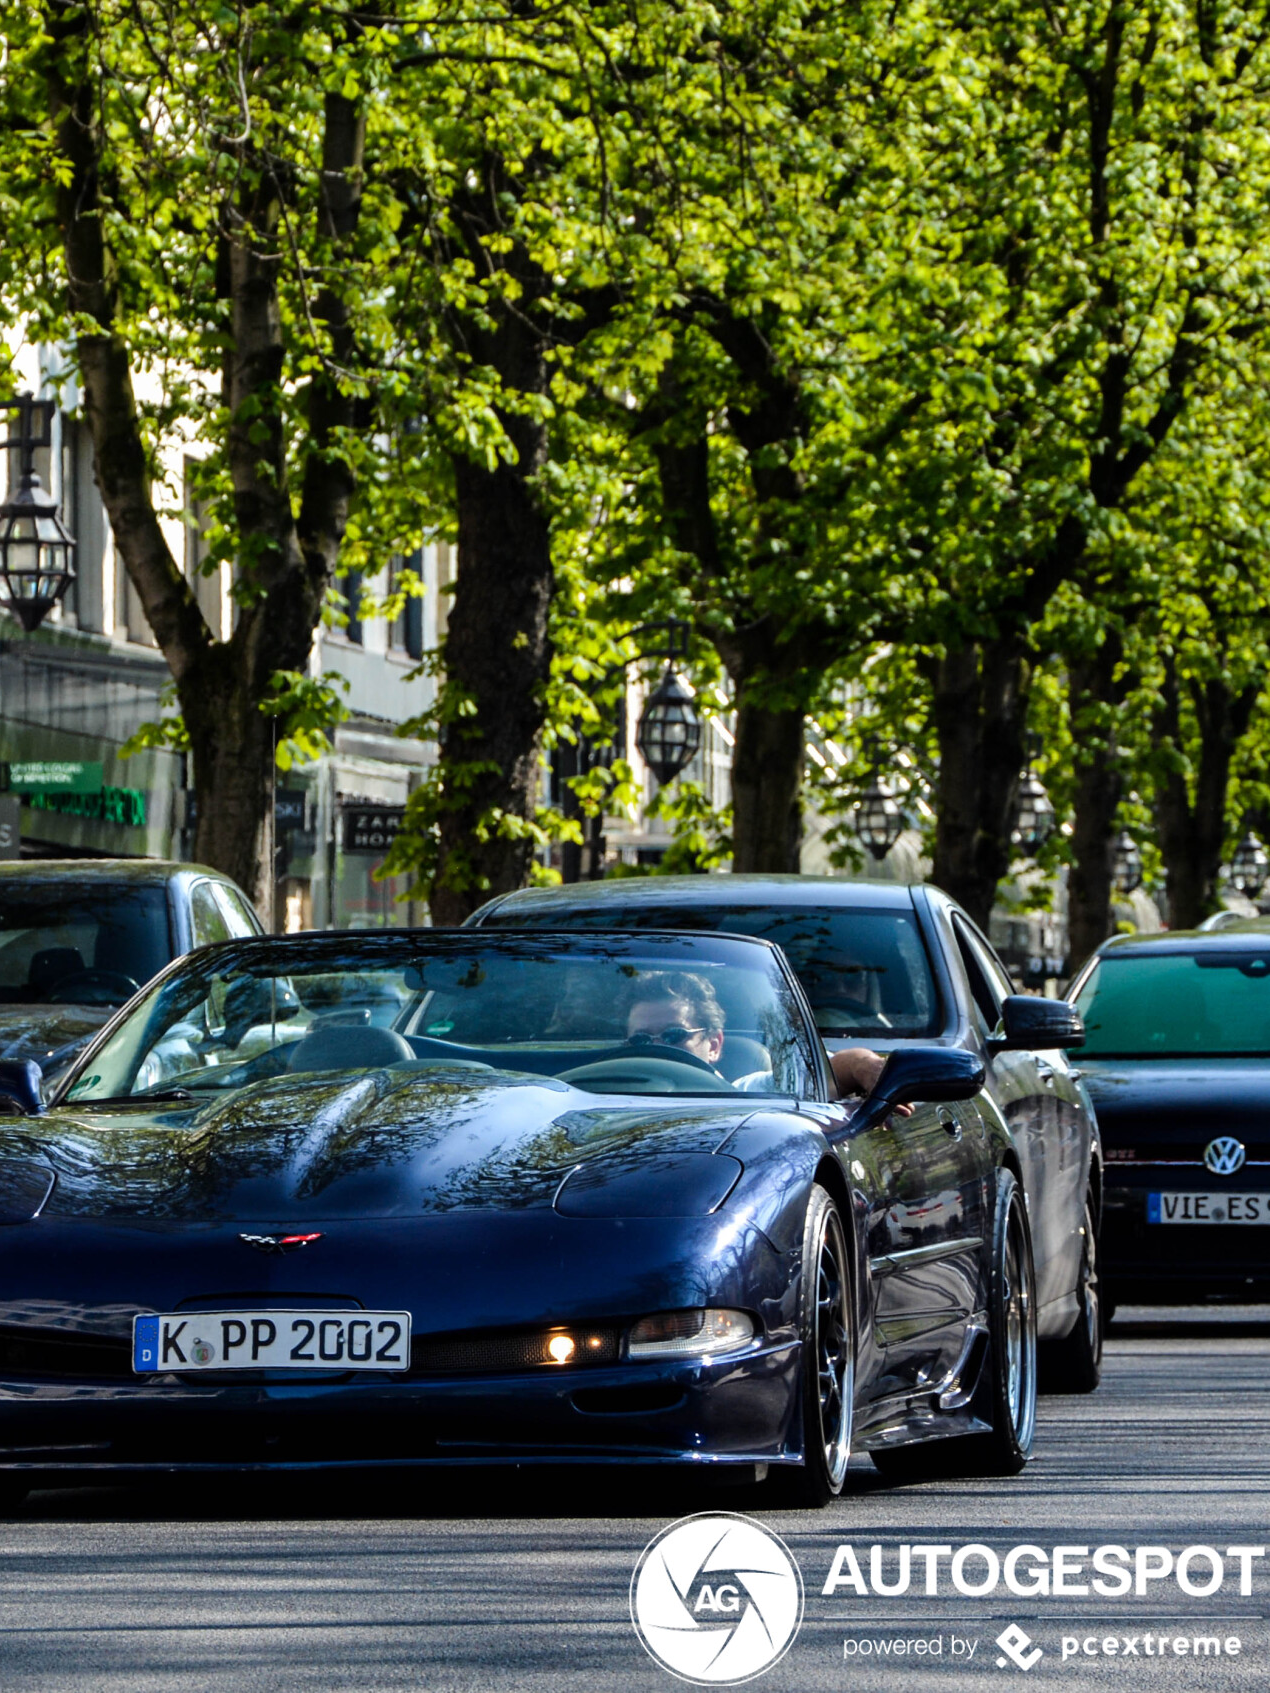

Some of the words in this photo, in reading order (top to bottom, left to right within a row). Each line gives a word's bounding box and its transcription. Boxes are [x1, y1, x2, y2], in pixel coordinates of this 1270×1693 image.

[356, 815, 400, 829] ZAR
[1163, 1196, 1210, 1219] VIE
[1227, 1197, 1260, 1220] ES
[162, 1321, 189, 1363] K
[221, 1319, 277, 1362] PP
[290, 1319, 401, 1362] 2002
[142, 1349, 152, 1362] D
